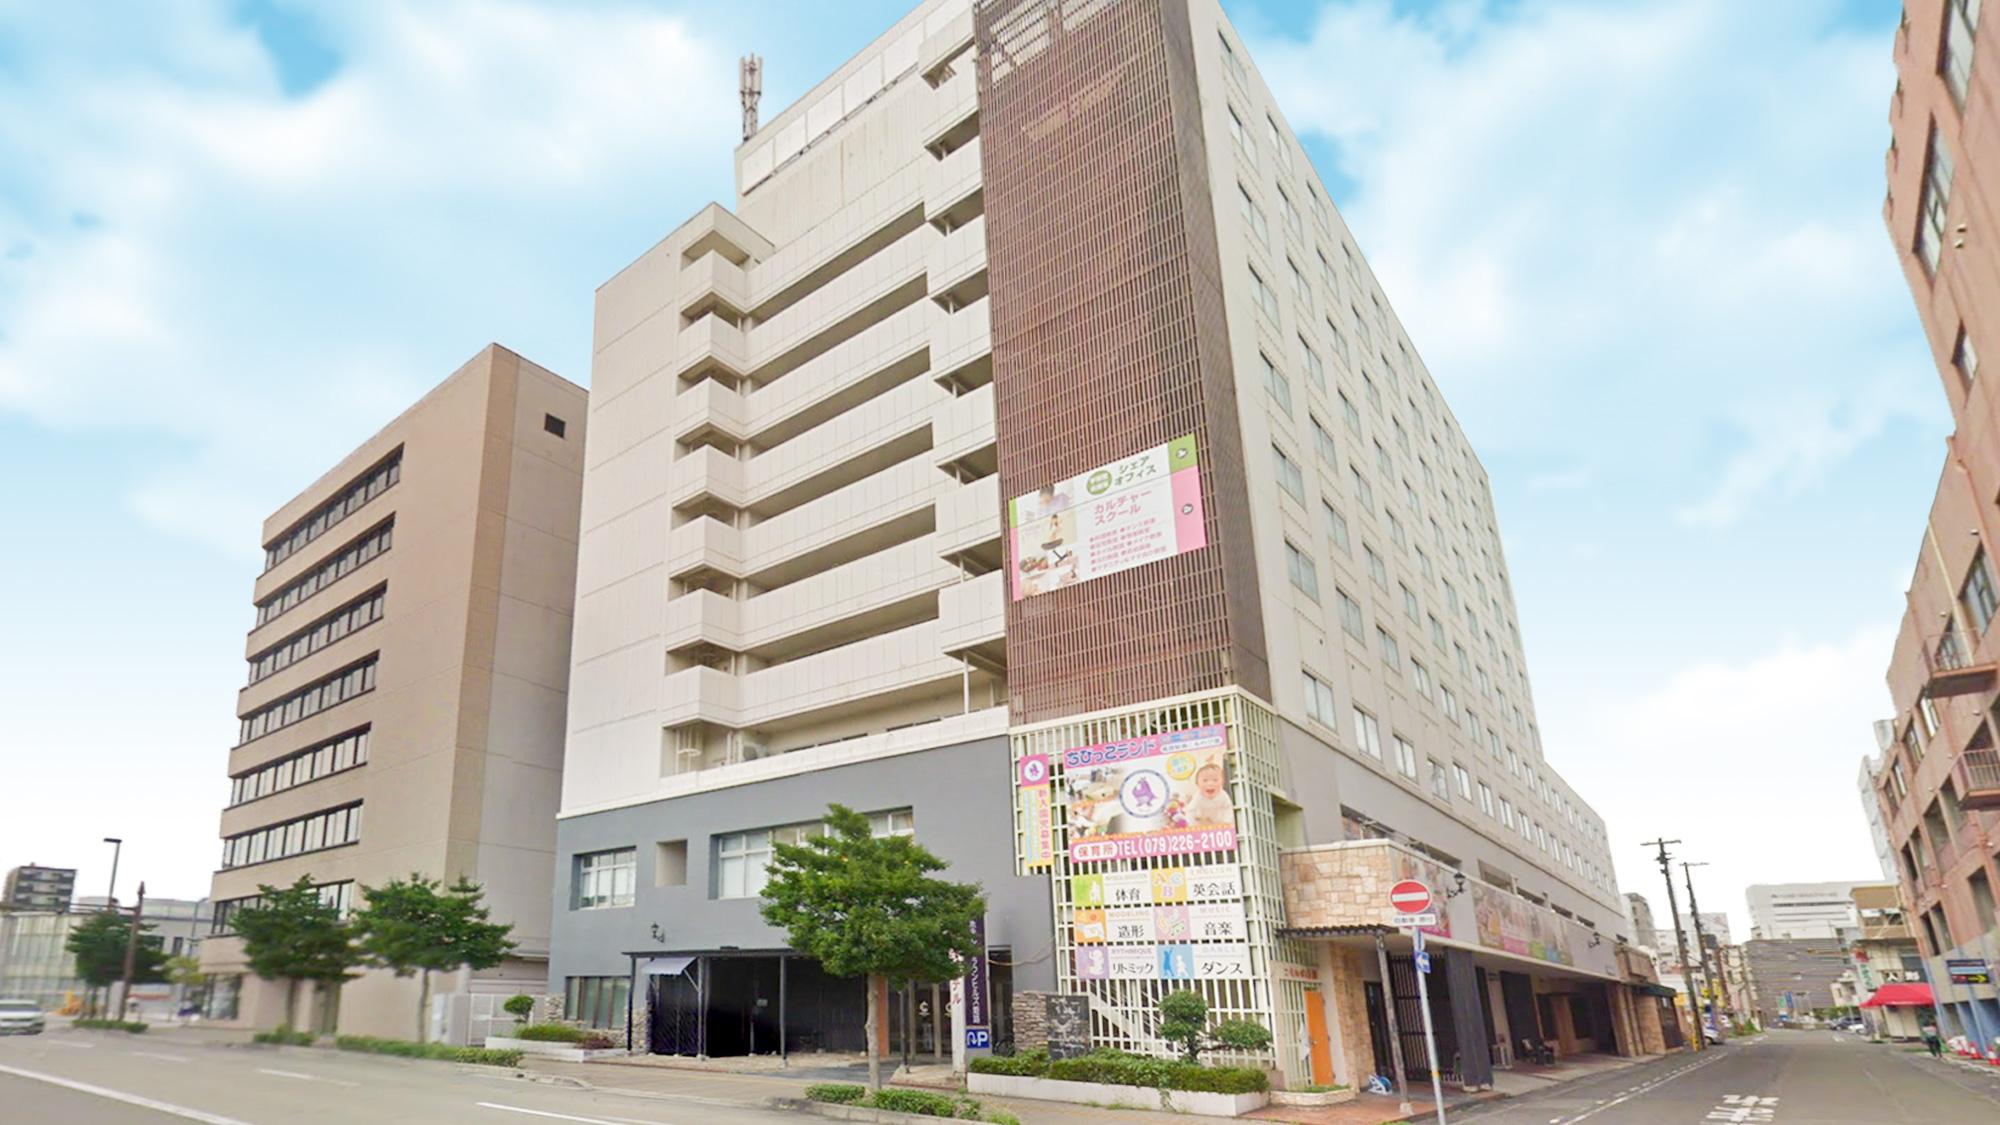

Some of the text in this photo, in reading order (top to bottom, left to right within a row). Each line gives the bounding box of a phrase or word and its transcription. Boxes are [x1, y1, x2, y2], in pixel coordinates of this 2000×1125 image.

[1119, 455, 1150, 474] シェア
[1114, 464, 1157, 486] オフィス
[1094, 490, 1153, 514] カルチャー
[1094, 503, 1142, 526] スクール
[1066, 739, 1156, 766] ちびっこランド
[1115, 887, 1141, 902] 体育
[1193, 881, 1236, 897] 英会話
[1117, 924, 1145, 939] 造形
[1204, 921, 1233, 936] 音楽
[1112, 962, 1155, 975] リトミック
[1201, 961, 1244, 975] ダンス
[977, 1031, 988, 1047] P
